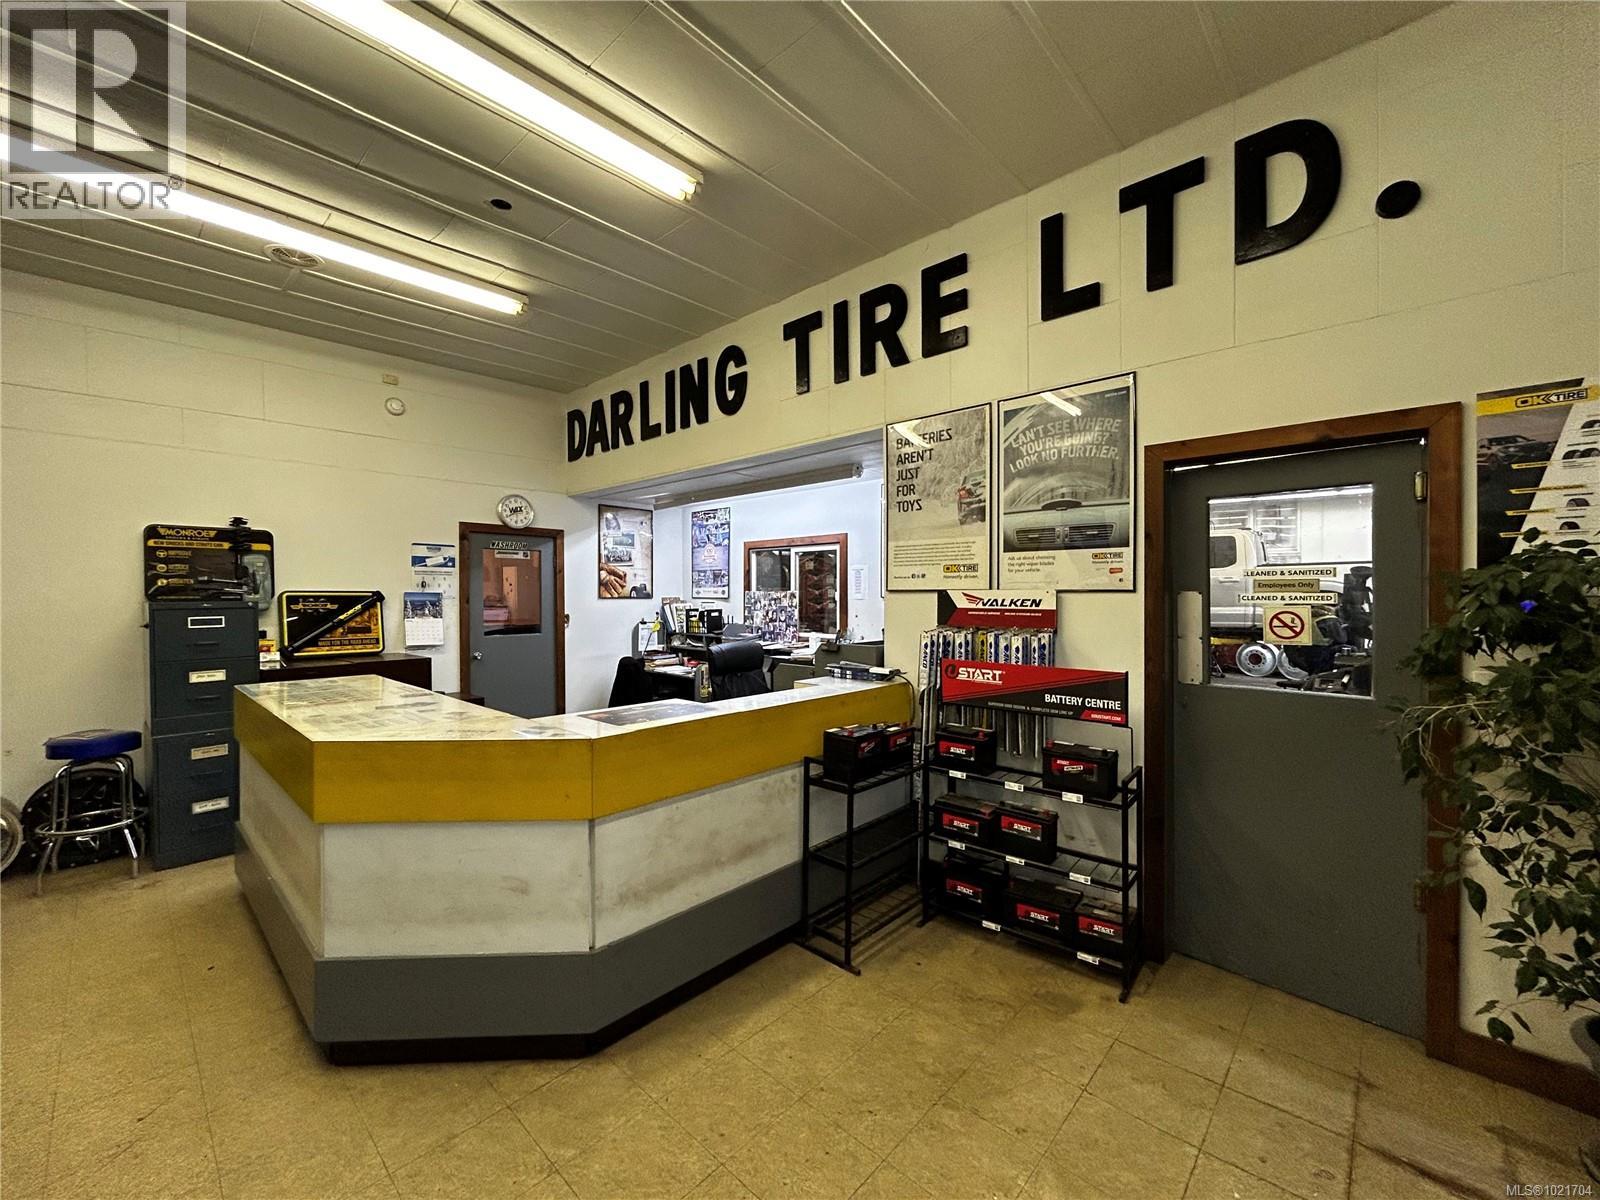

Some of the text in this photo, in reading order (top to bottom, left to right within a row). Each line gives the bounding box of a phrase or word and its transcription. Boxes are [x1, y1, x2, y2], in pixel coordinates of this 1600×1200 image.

[567, 119, 1421, 462] DARLING TIRE LTD.
[1046, 420, 1070, 435] SEE
[1072, 417, 1121, 432] WHERE
[896, 428, 952, 450] BAERIES
[1019, 432, 1109, 456] YOU'RE GOING?
[896, 448, 934, 466] AREN'T
[1009, 445, 1119, 473] LOOK NO FURTHER.
[896, 466, 921, 482] JUST
[896, 483, 916, 497] FOR
[896, 499, 922, 513] TOYS
[165, 528, 211, 538] MONROE
[981, 598, 1043, 608] VALKEN
[957, 667, 1003, 682] START
[1044, 693, 1121, 710] BATTERY CENTRE
[1030, 911, 1049, 922] START
[1092, 924, 1115, 936] START
